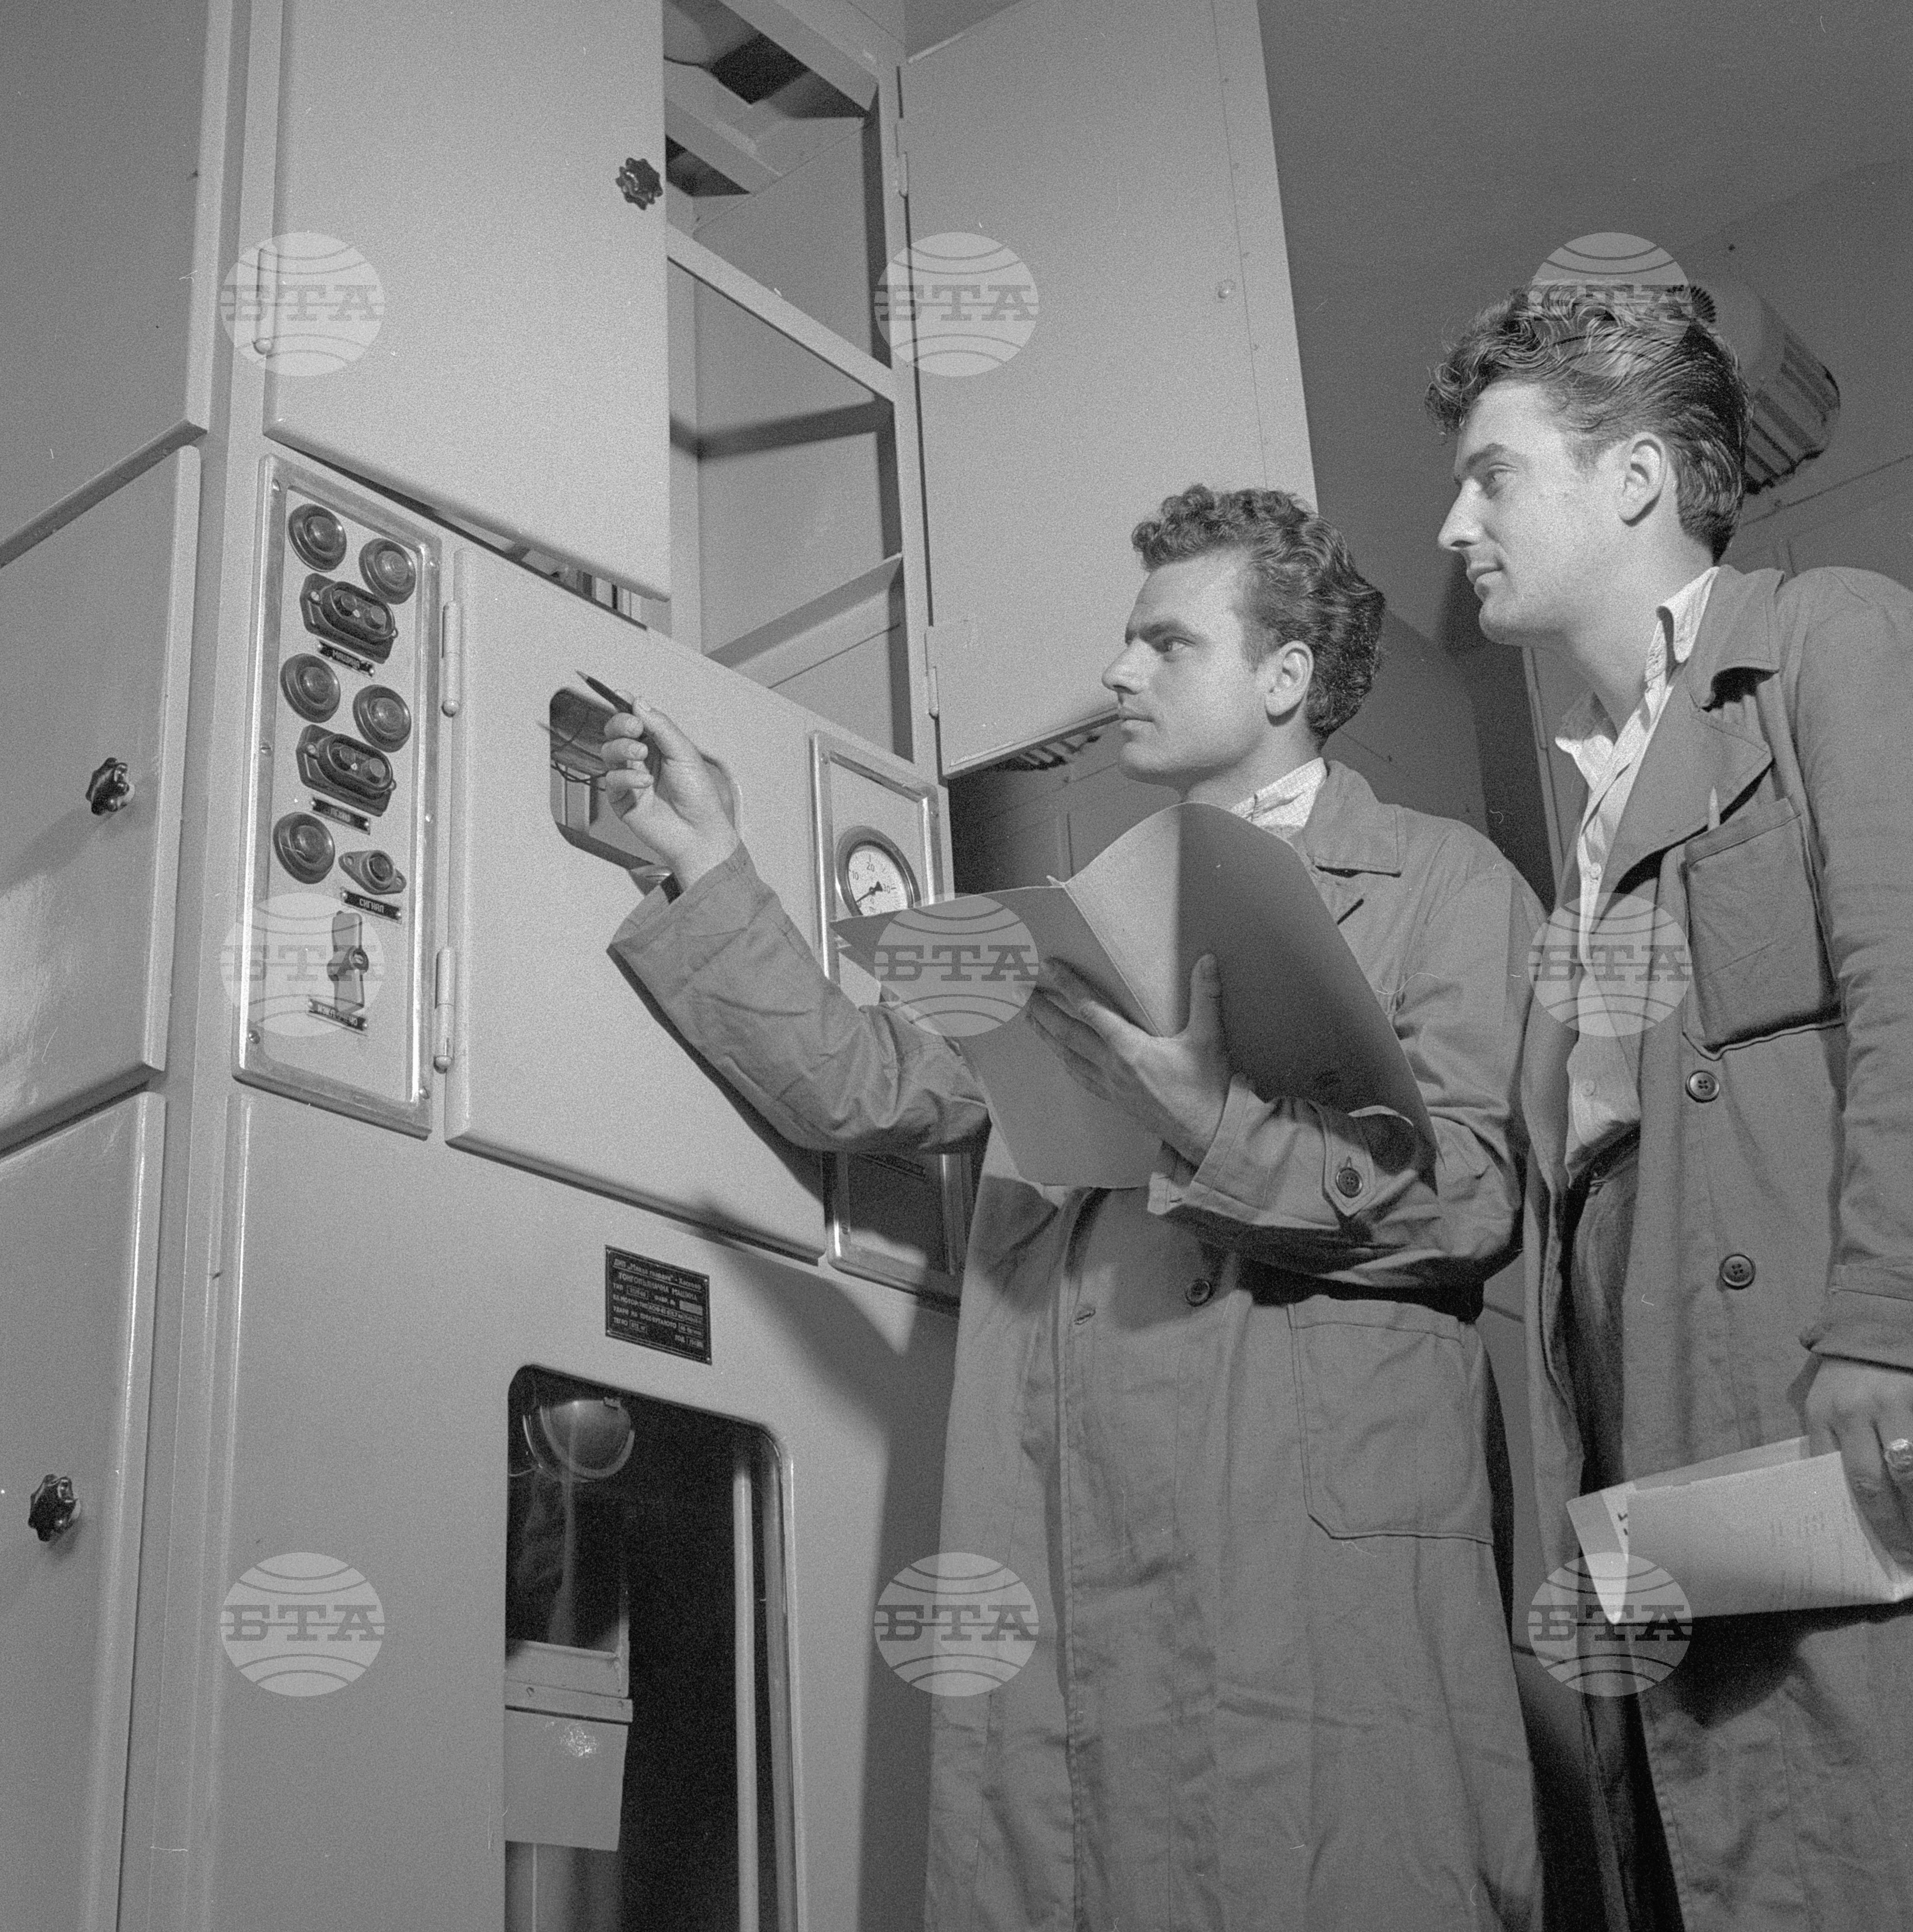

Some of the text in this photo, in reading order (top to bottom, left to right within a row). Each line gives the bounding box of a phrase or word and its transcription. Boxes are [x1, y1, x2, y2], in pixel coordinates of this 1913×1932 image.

[866, 862, 875, 872] 20
[359, 898, 384, 913] СИГНАЛ
[614, 1258, 626, 1268] ДИП
[678, 1278, 701, 1290] Хасково
[613, 1282, 623, 1291] ТИП
[671, 1287, 697, 1301] МАШИНА
